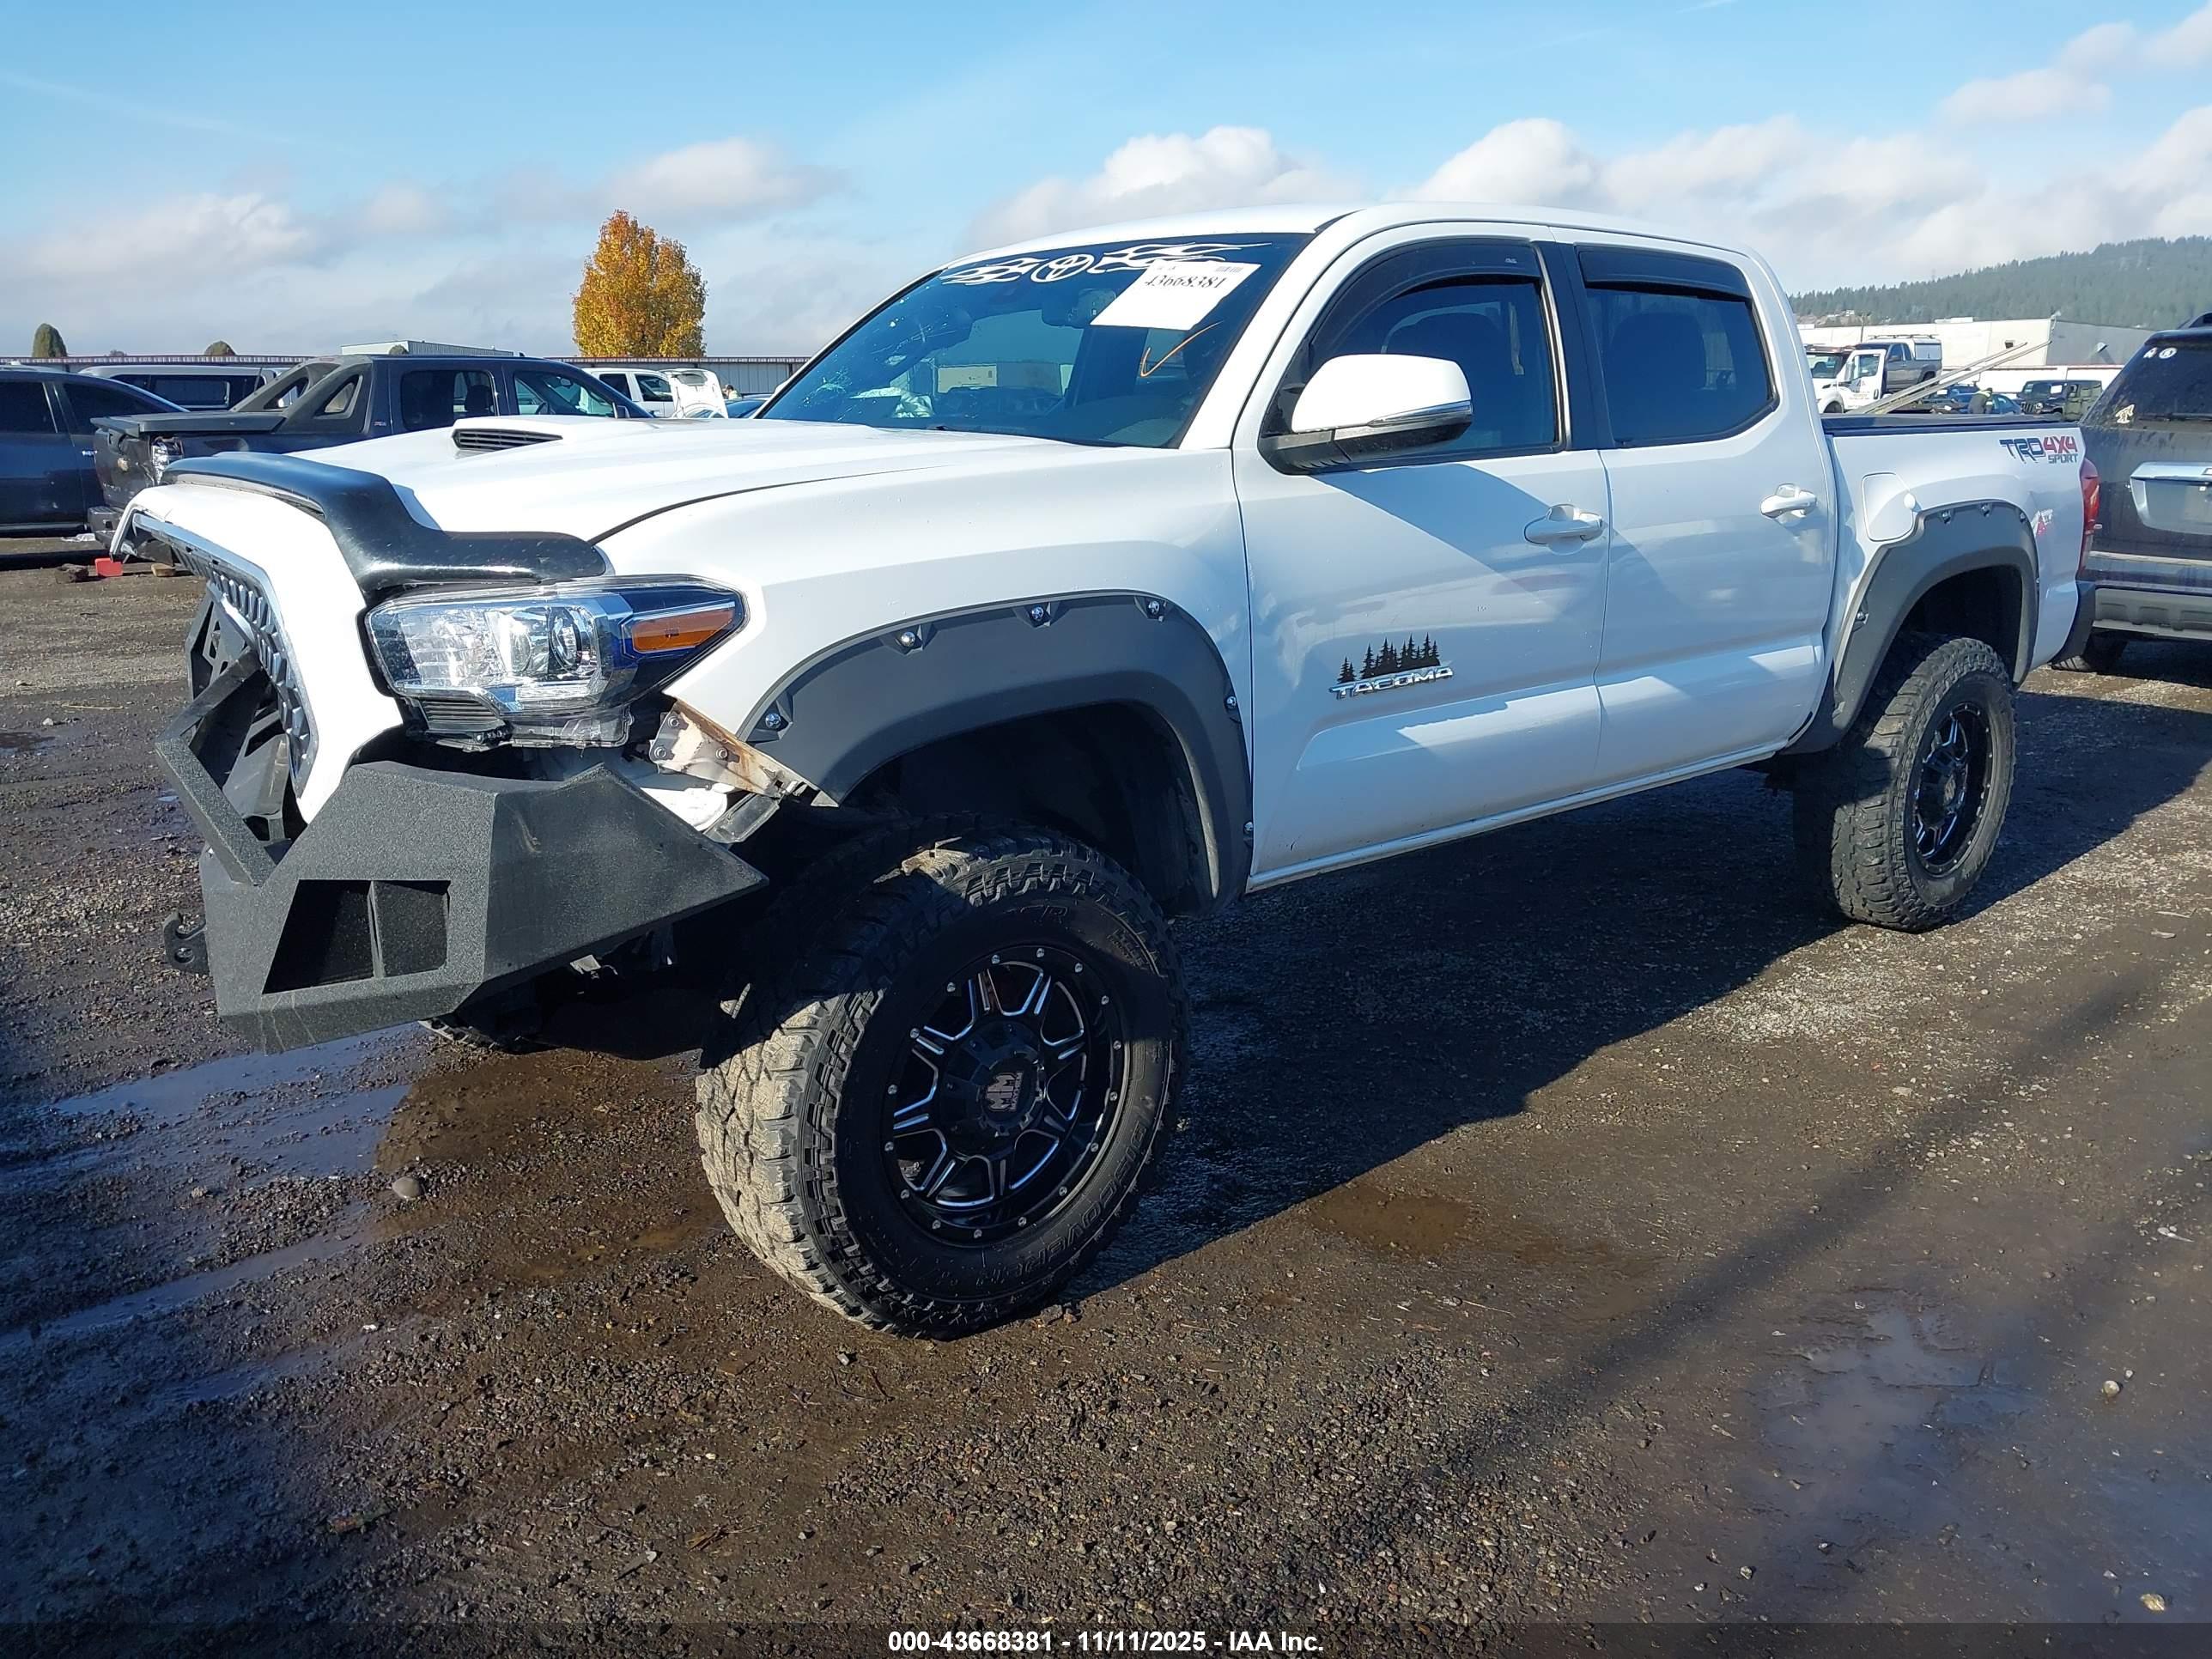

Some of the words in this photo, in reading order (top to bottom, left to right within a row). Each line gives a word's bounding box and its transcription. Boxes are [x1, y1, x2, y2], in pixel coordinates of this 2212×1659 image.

[1144, 273, 1228, 289] 43668381
[2048, 453, 2079, 464] SPORT
[1329, 665, 1455, 700] TACOMA
